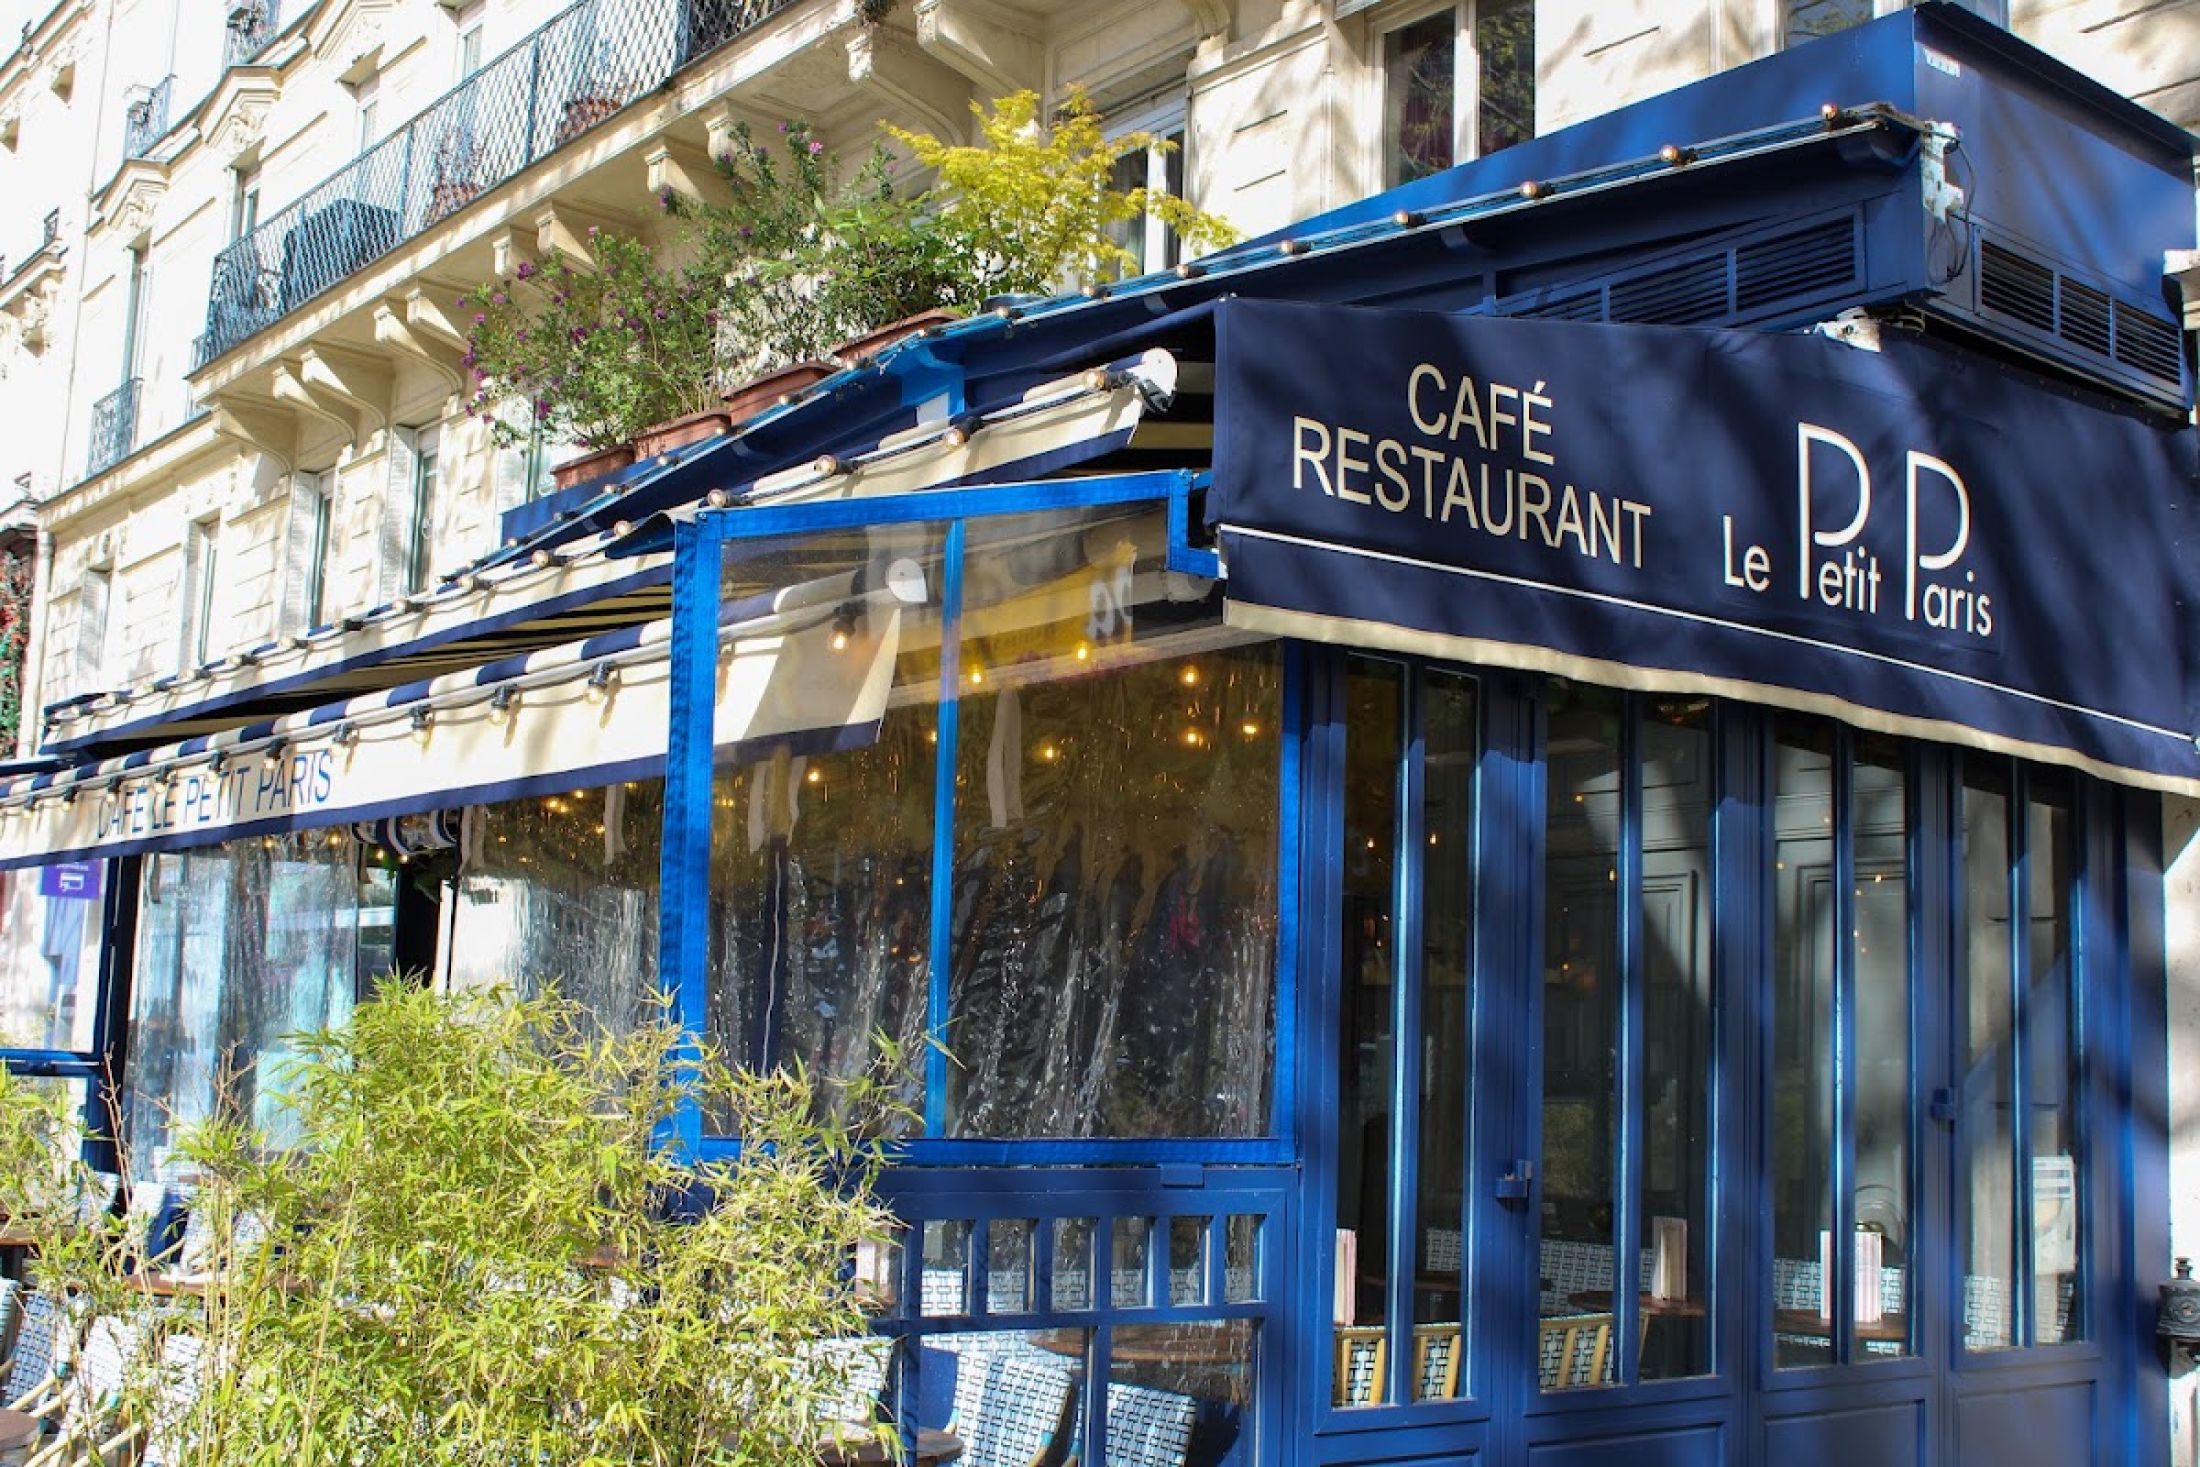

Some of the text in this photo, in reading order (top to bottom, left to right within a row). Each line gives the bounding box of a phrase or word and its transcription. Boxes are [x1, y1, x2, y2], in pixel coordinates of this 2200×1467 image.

[1409, 363, 1554, 465] CAFÉ
[1293, 416, 1651, 569] RESTAURANT
[1723, 422, 1993, 637] Le Petit Paris
[152, 778, 177, 830] LE
[182, 766, 251, 825] PETIT
[256, 750, 332, 813] PARIS
